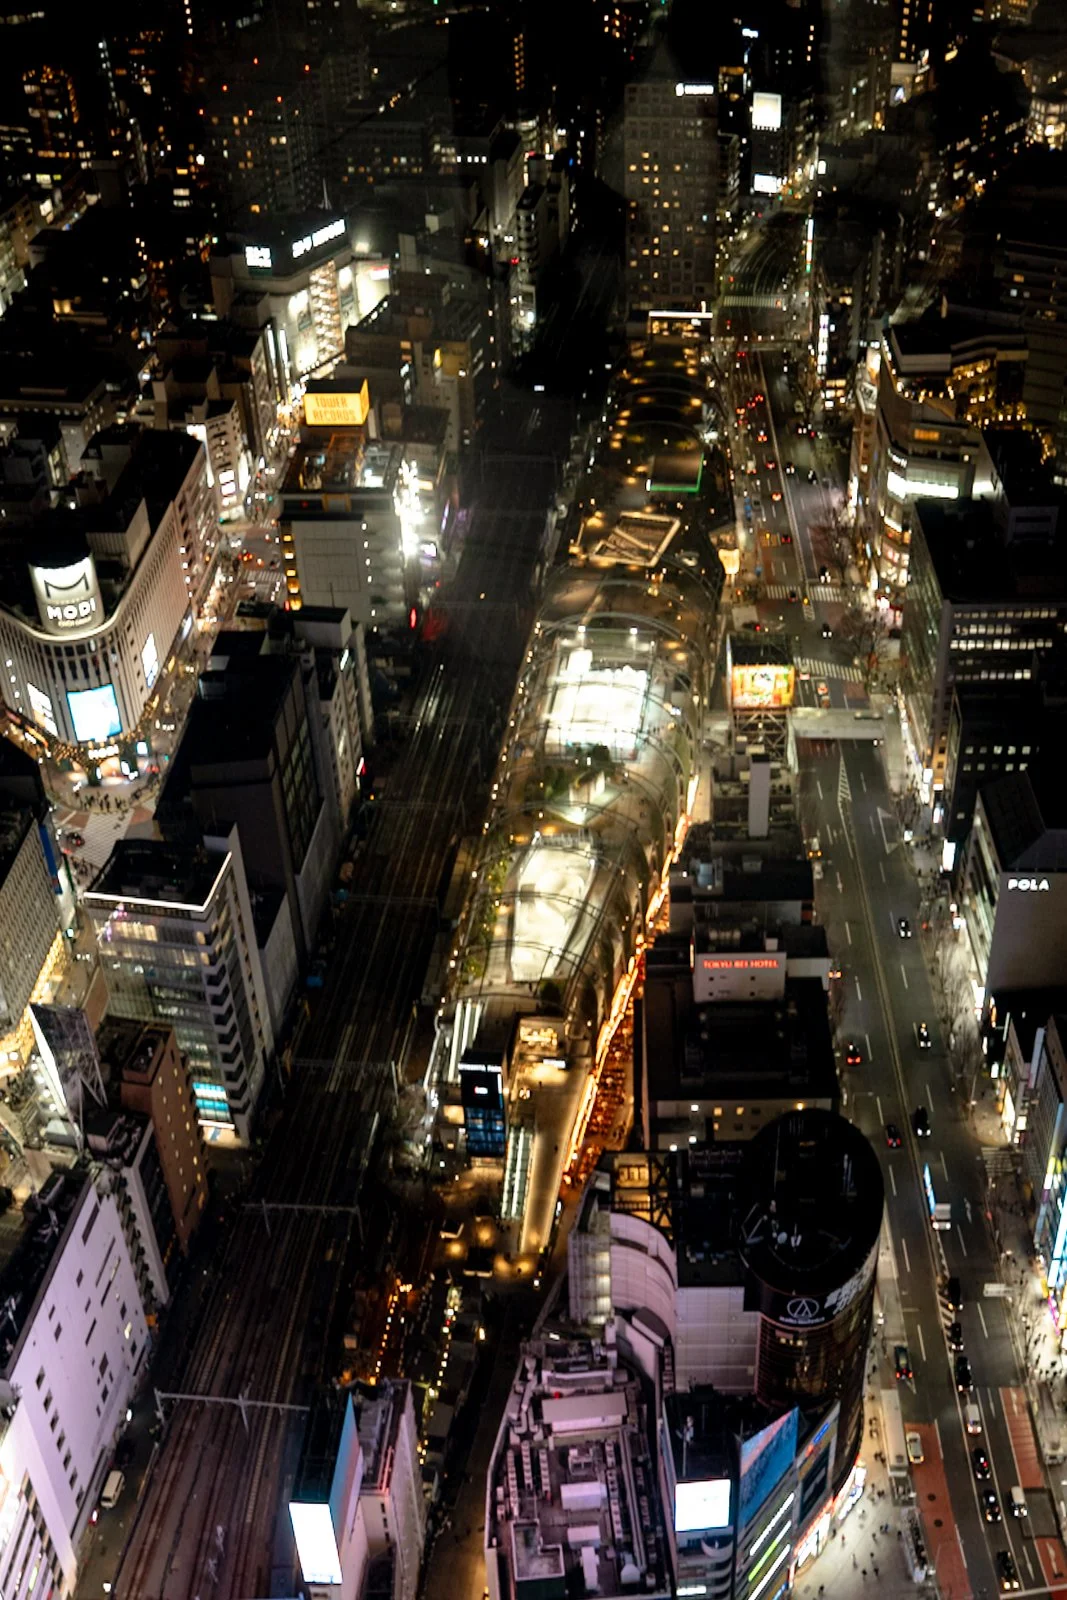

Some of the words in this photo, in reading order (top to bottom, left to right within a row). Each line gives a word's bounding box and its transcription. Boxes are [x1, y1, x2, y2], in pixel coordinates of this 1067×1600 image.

[315, 396, 348, 408] TOWER
[312, 409, 357, 422] RECORDS
[46, 597, 96, 620] MODI
[1007, 878, 1050, 891] POLA
[750, 960, 779, 969] HOTEL
